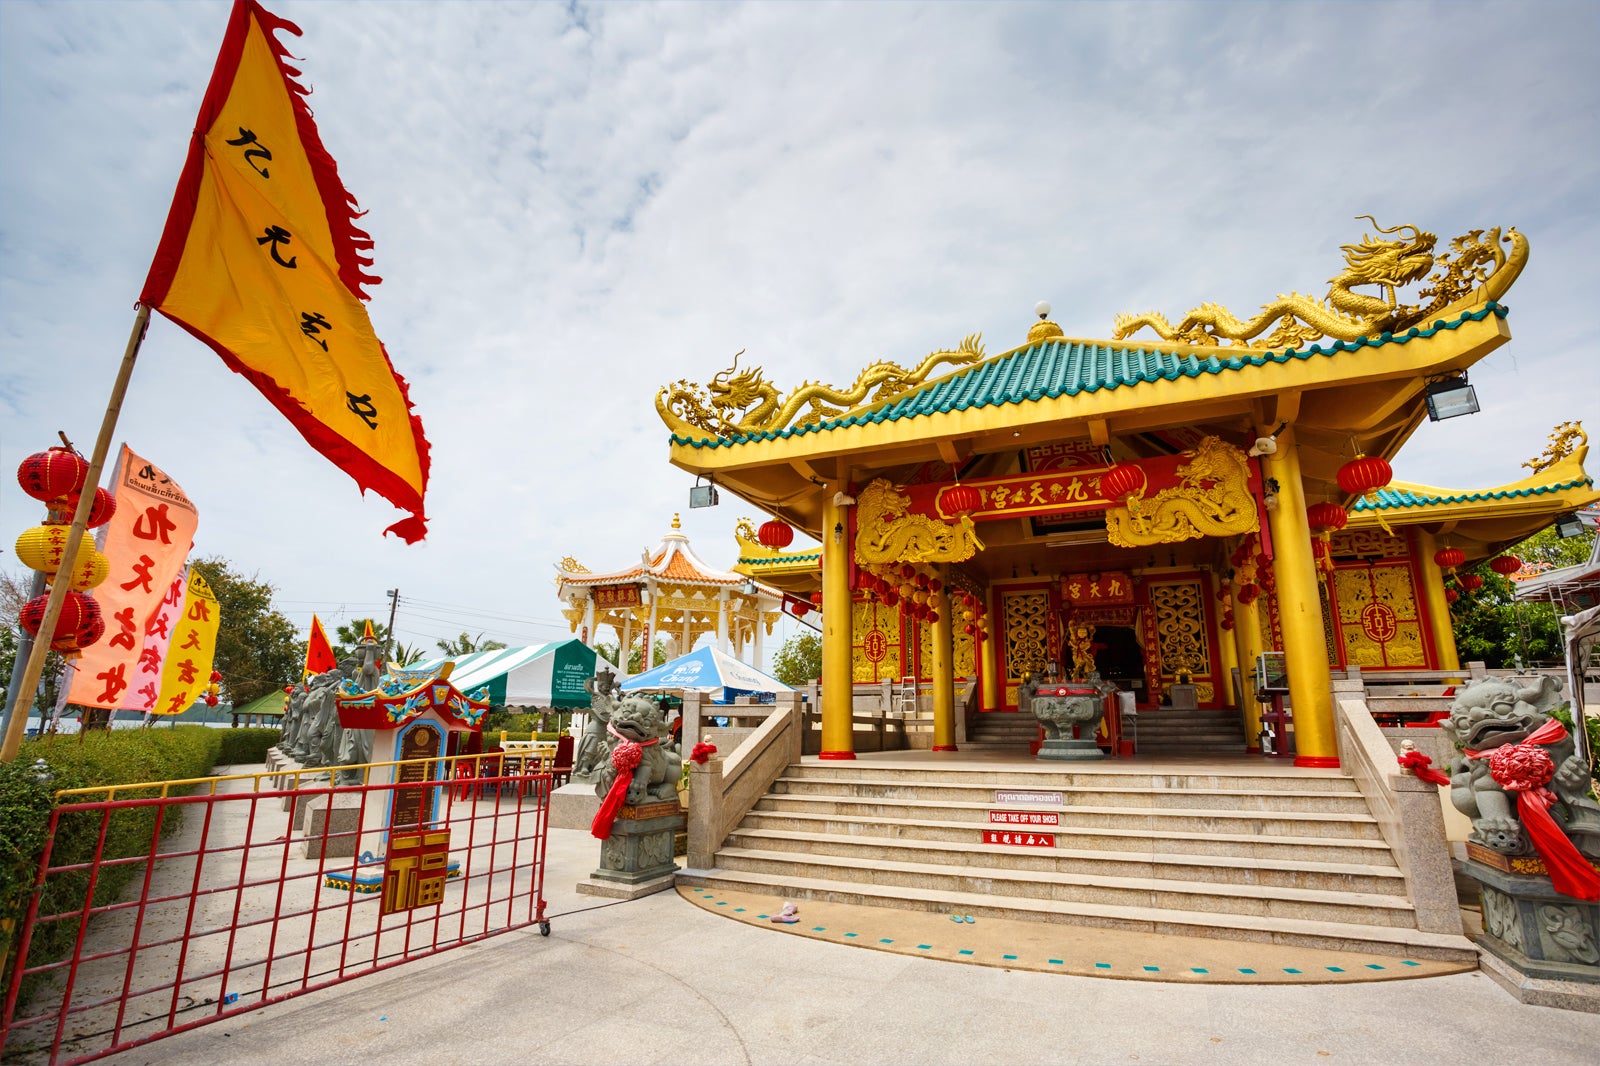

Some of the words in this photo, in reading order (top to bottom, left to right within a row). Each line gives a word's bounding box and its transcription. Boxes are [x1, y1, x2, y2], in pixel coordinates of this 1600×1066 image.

[1068, 579, 1124, 600] 九天宮
[659, 673, 701, 684] Chang
[991, 813, 1007, 822] PLEASE
[1008, 813, 1019, 822] TAKE
[1020, 814, 1029, 823] OFF
[1029, 814, 1041, 824] YOUR
[1042, 815, 1057, 824] SHOES
